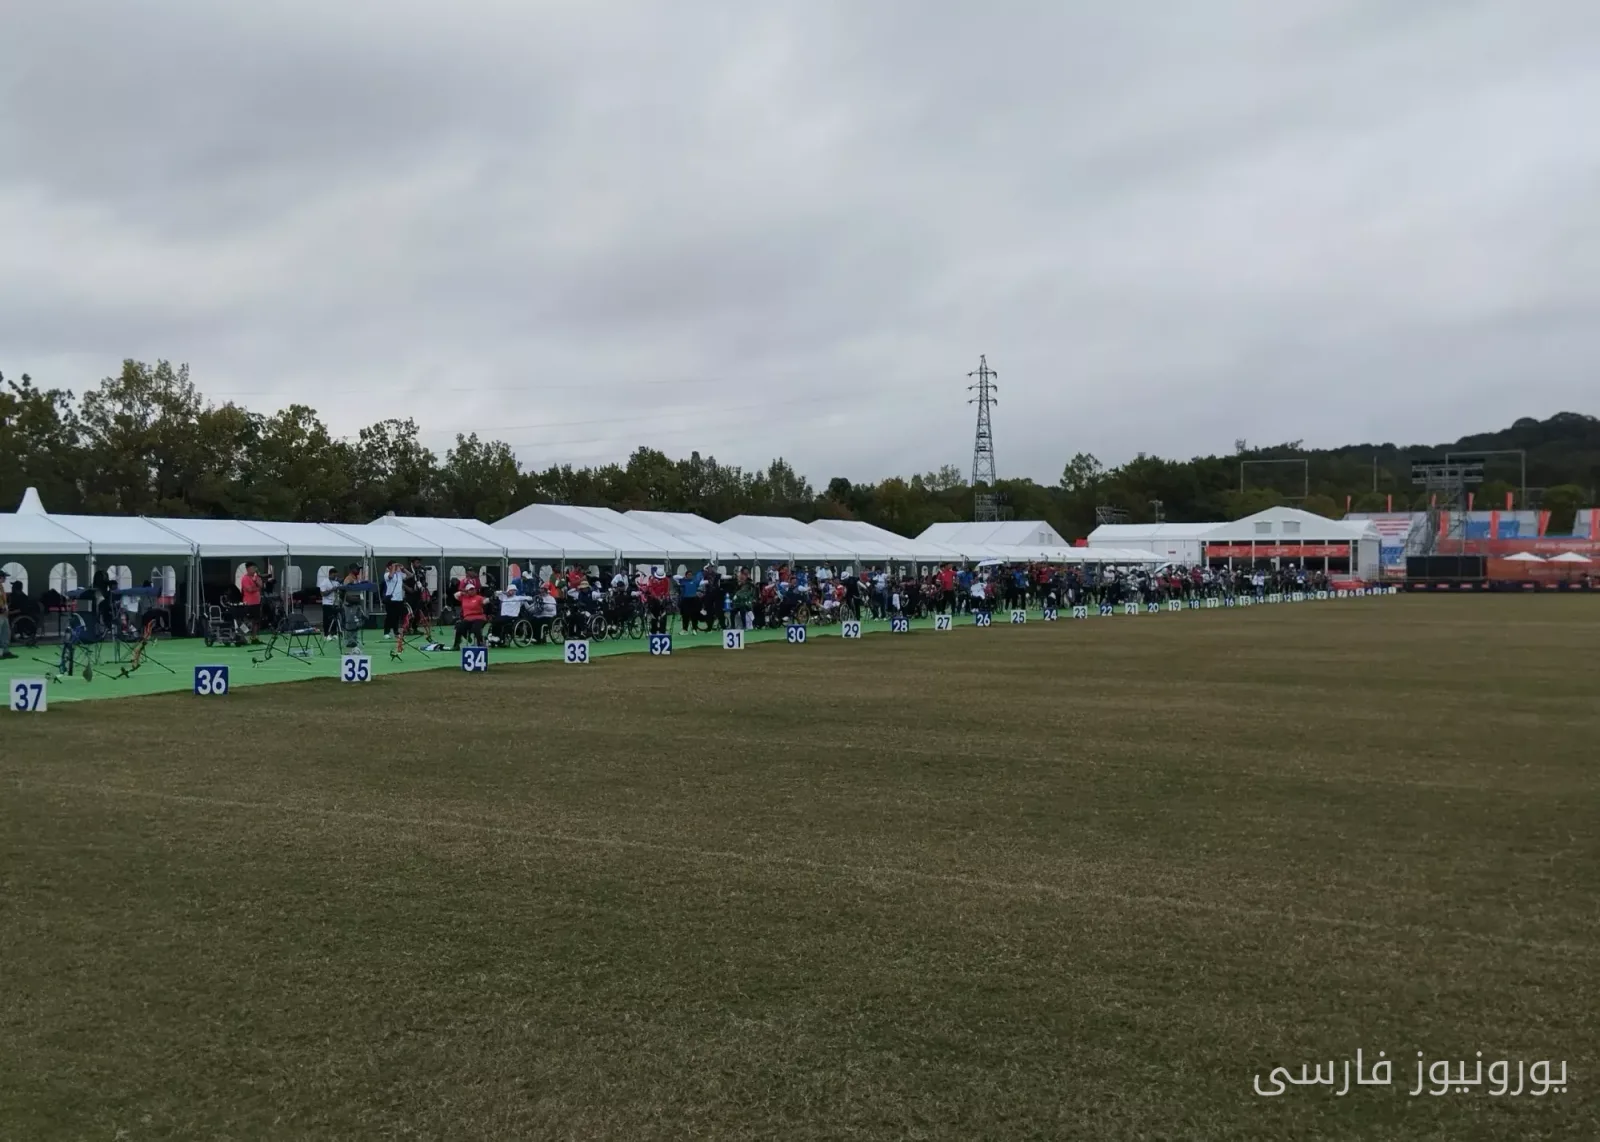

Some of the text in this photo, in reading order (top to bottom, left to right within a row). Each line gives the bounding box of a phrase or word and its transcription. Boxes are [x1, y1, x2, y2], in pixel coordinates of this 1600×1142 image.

[1190, 600, 1200, 609] 18
[1208, 599, 1217, 608] 17
[1225, 598, 1235, 607] 16
[1241, 597, 1250, 606] 15
[1256, 596, 1264, 604] 14
[1101, 606, 1113, 616] 22
[1127, 604, 1137, 615] 21
[1148, 602, 1159, 613] 20
[1170, 602, 1180, 611] 19
[1012, 611, 1025, 623] 25
[1044, 609, 1057, 621] 24
[1074, 608, 1086, 618] 23
[893, 619, 908, 632] 28
[937, 617, 950, 630] 27
[976, 613, 991, 626] 26
[788, 626, 806, 643] 30
[844, 623, 860, 638] 29
[726, 632, 741, 648] 31
[567, 643, 587, 662] 33
[651, 637, 671, 656] 32
[464, 650, 487, 672] 34
[344, 658, 369, 682] 35
[197, 669, 226, 695] 36
[14, 683, 43, 711] 37
